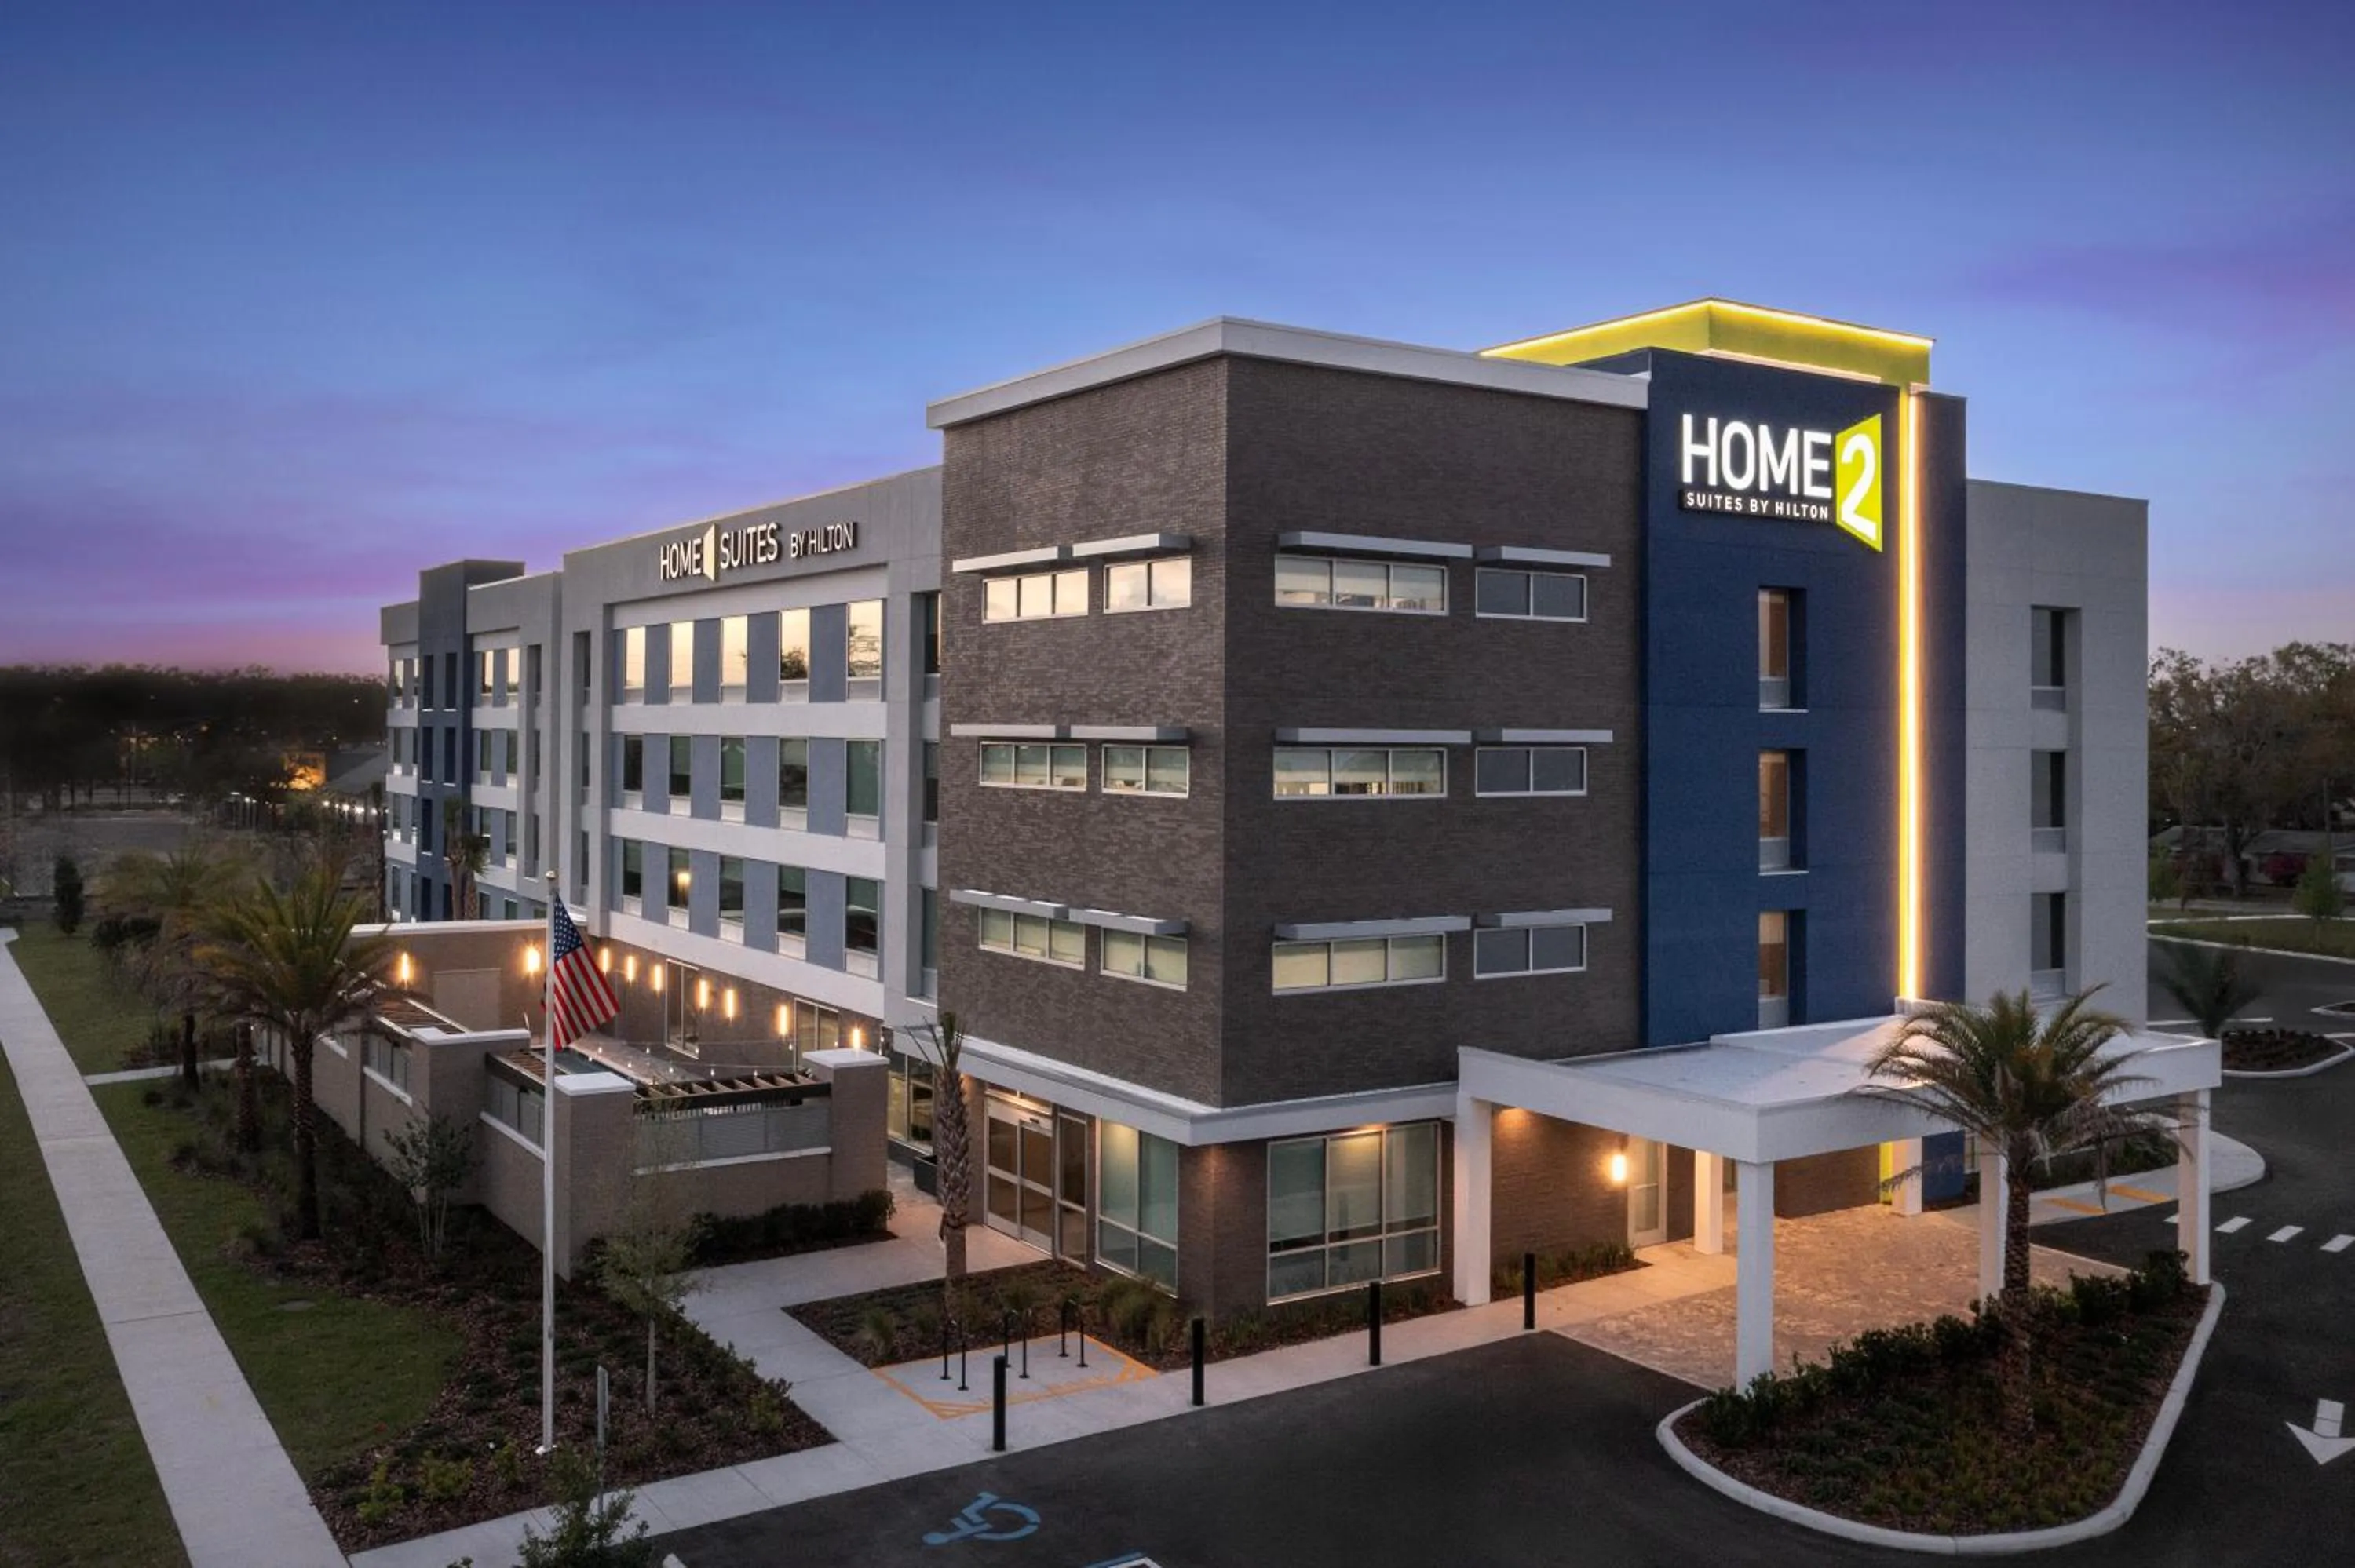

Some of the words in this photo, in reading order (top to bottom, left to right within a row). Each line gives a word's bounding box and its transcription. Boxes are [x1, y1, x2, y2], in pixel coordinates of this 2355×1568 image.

[1682, 414, 1831, 498] HOME
[1841, 433, 1876, 541] 2
[1687, 492, 1743, 511] SUITES
[1750, 498, 1769, 513] BY
[1775, 502, 1828, 520] HILTON
[660, 538, 702, 580] HOME
[720, 522, 778, 569] SUITES
[790, 532, 805, 558] BY
[809, 522, 854, 554] HILTON
